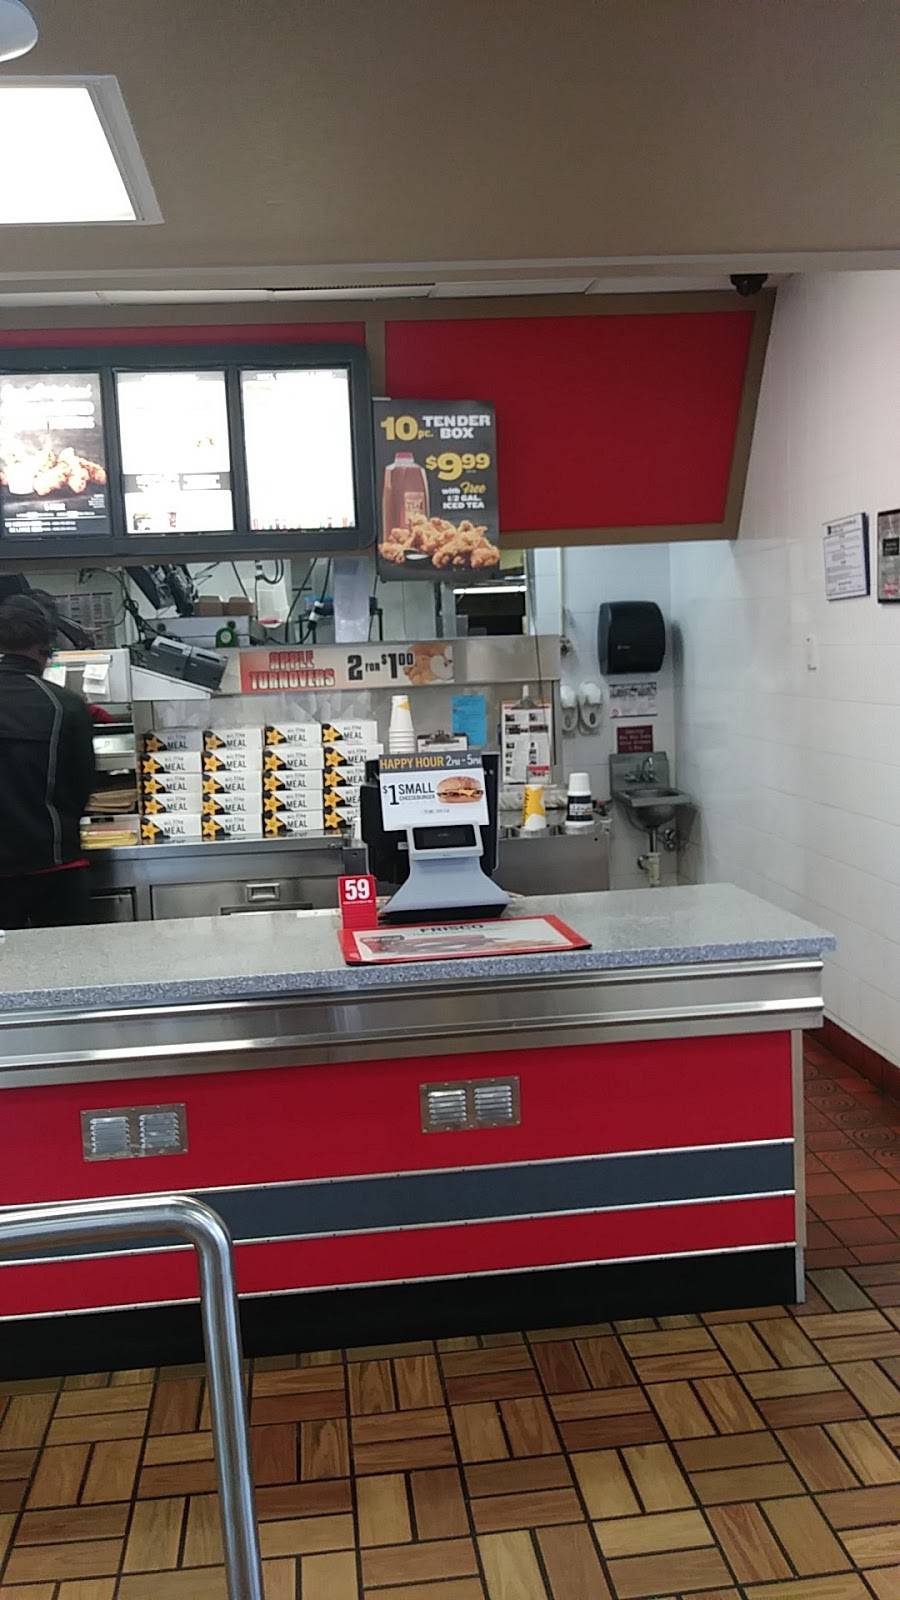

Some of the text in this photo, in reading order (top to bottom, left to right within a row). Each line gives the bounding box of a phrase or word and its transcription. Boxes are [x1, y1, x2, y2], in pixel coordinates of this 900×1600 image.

[422, 414, 491, 427] TENDER
[439, 427, 475, 439] BOX
[441, 481, 487, 495] with Free
[442, 502, 485, 510] ICED TEA
[347, 655, 363, 681] 2
[365, 661, 380, 672] FOR
[250, 668, 335, 690] TURNOVERS
[226, 739, 247, 747] MEAL
[226, 760, 247, 768] MEAL
[287, 759, 308, 767] MEAL
[380, 758, 413, 769] HAPPY
[415, 756, 444, 768] HOUR
[164, 763, 185, 771] MEAL
[165, 783, 187, 791] MEAL
[225, 783, 246, 791] MEAL
[382, 782, 435, 805] $1 SMALL
[167, 803, 188, 811] MEAL
[225, 803, 246, 811] MEAL
[286, 800, 308, 808] MEAL
[225, 823, 246, 832] MEAL
[287, 820, 308, 828] MEAL
[164, 826, 185, 834] MEAL
[344, 878, 370, 900] 59
[419, 924, 484, 933] FRISCO
